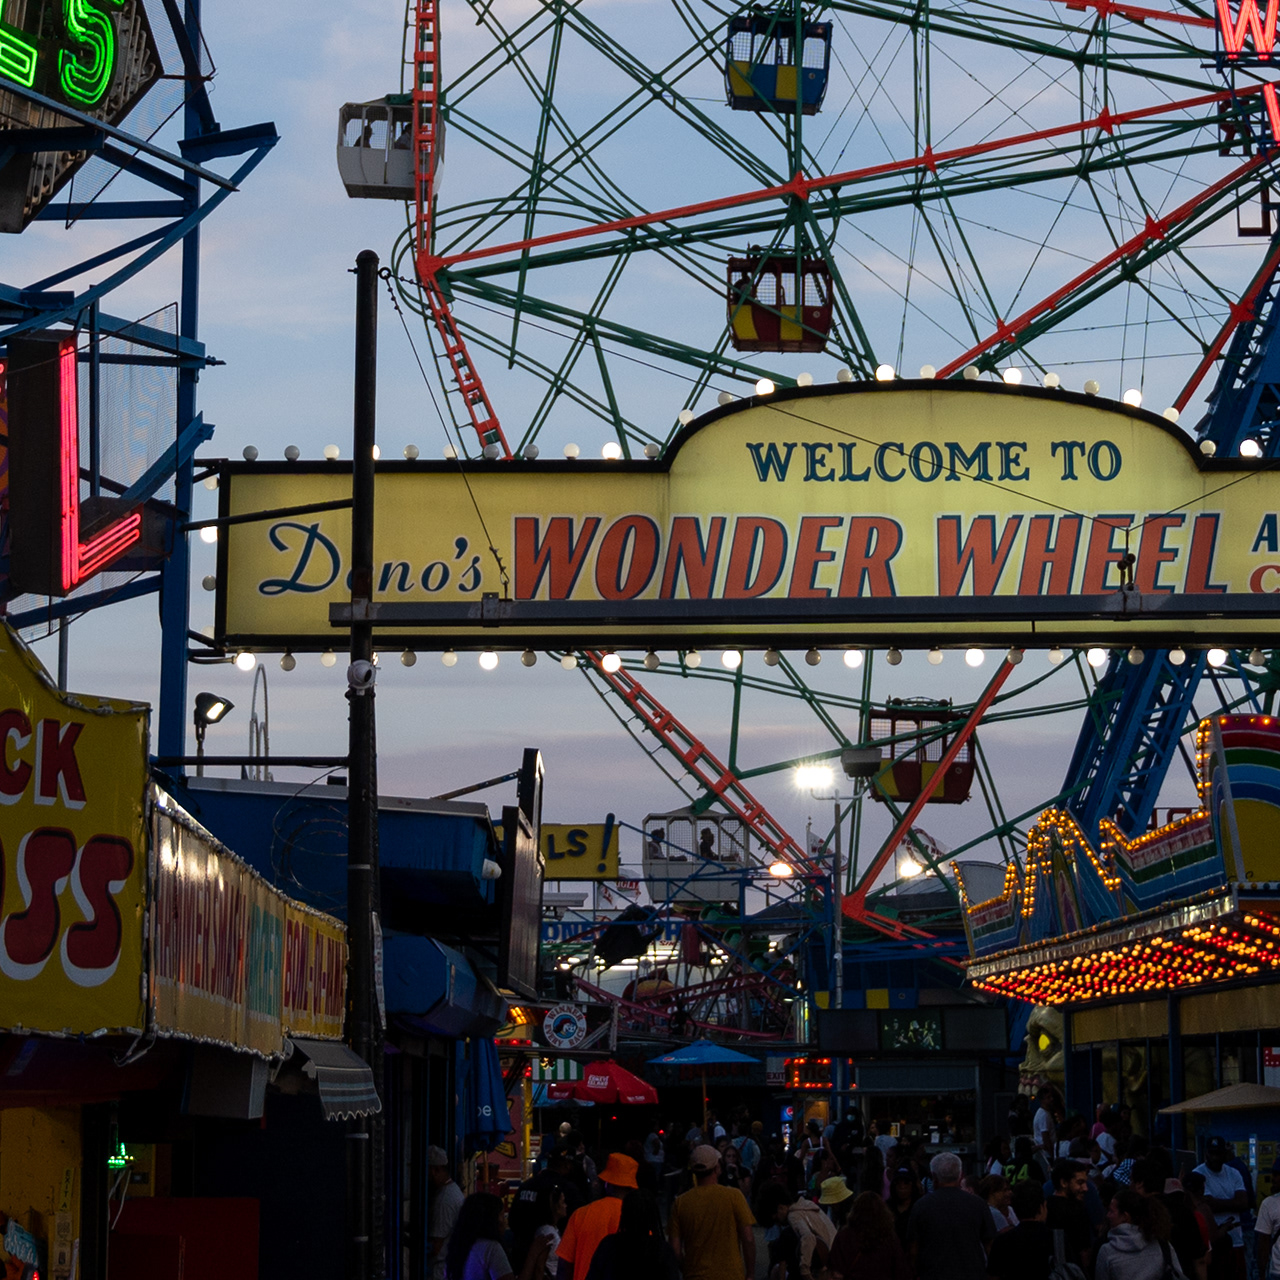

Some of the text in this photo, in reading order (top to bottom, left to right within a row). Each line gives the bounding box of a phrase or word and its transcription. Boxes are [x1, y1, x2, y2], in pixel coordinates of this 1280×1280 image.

[745, 440, 1122, 483] WELCOME TO
[258, 513, 1228, 600] Dno's WONDER WHEEL
[548, 1005, 583, 1022] WINNER
